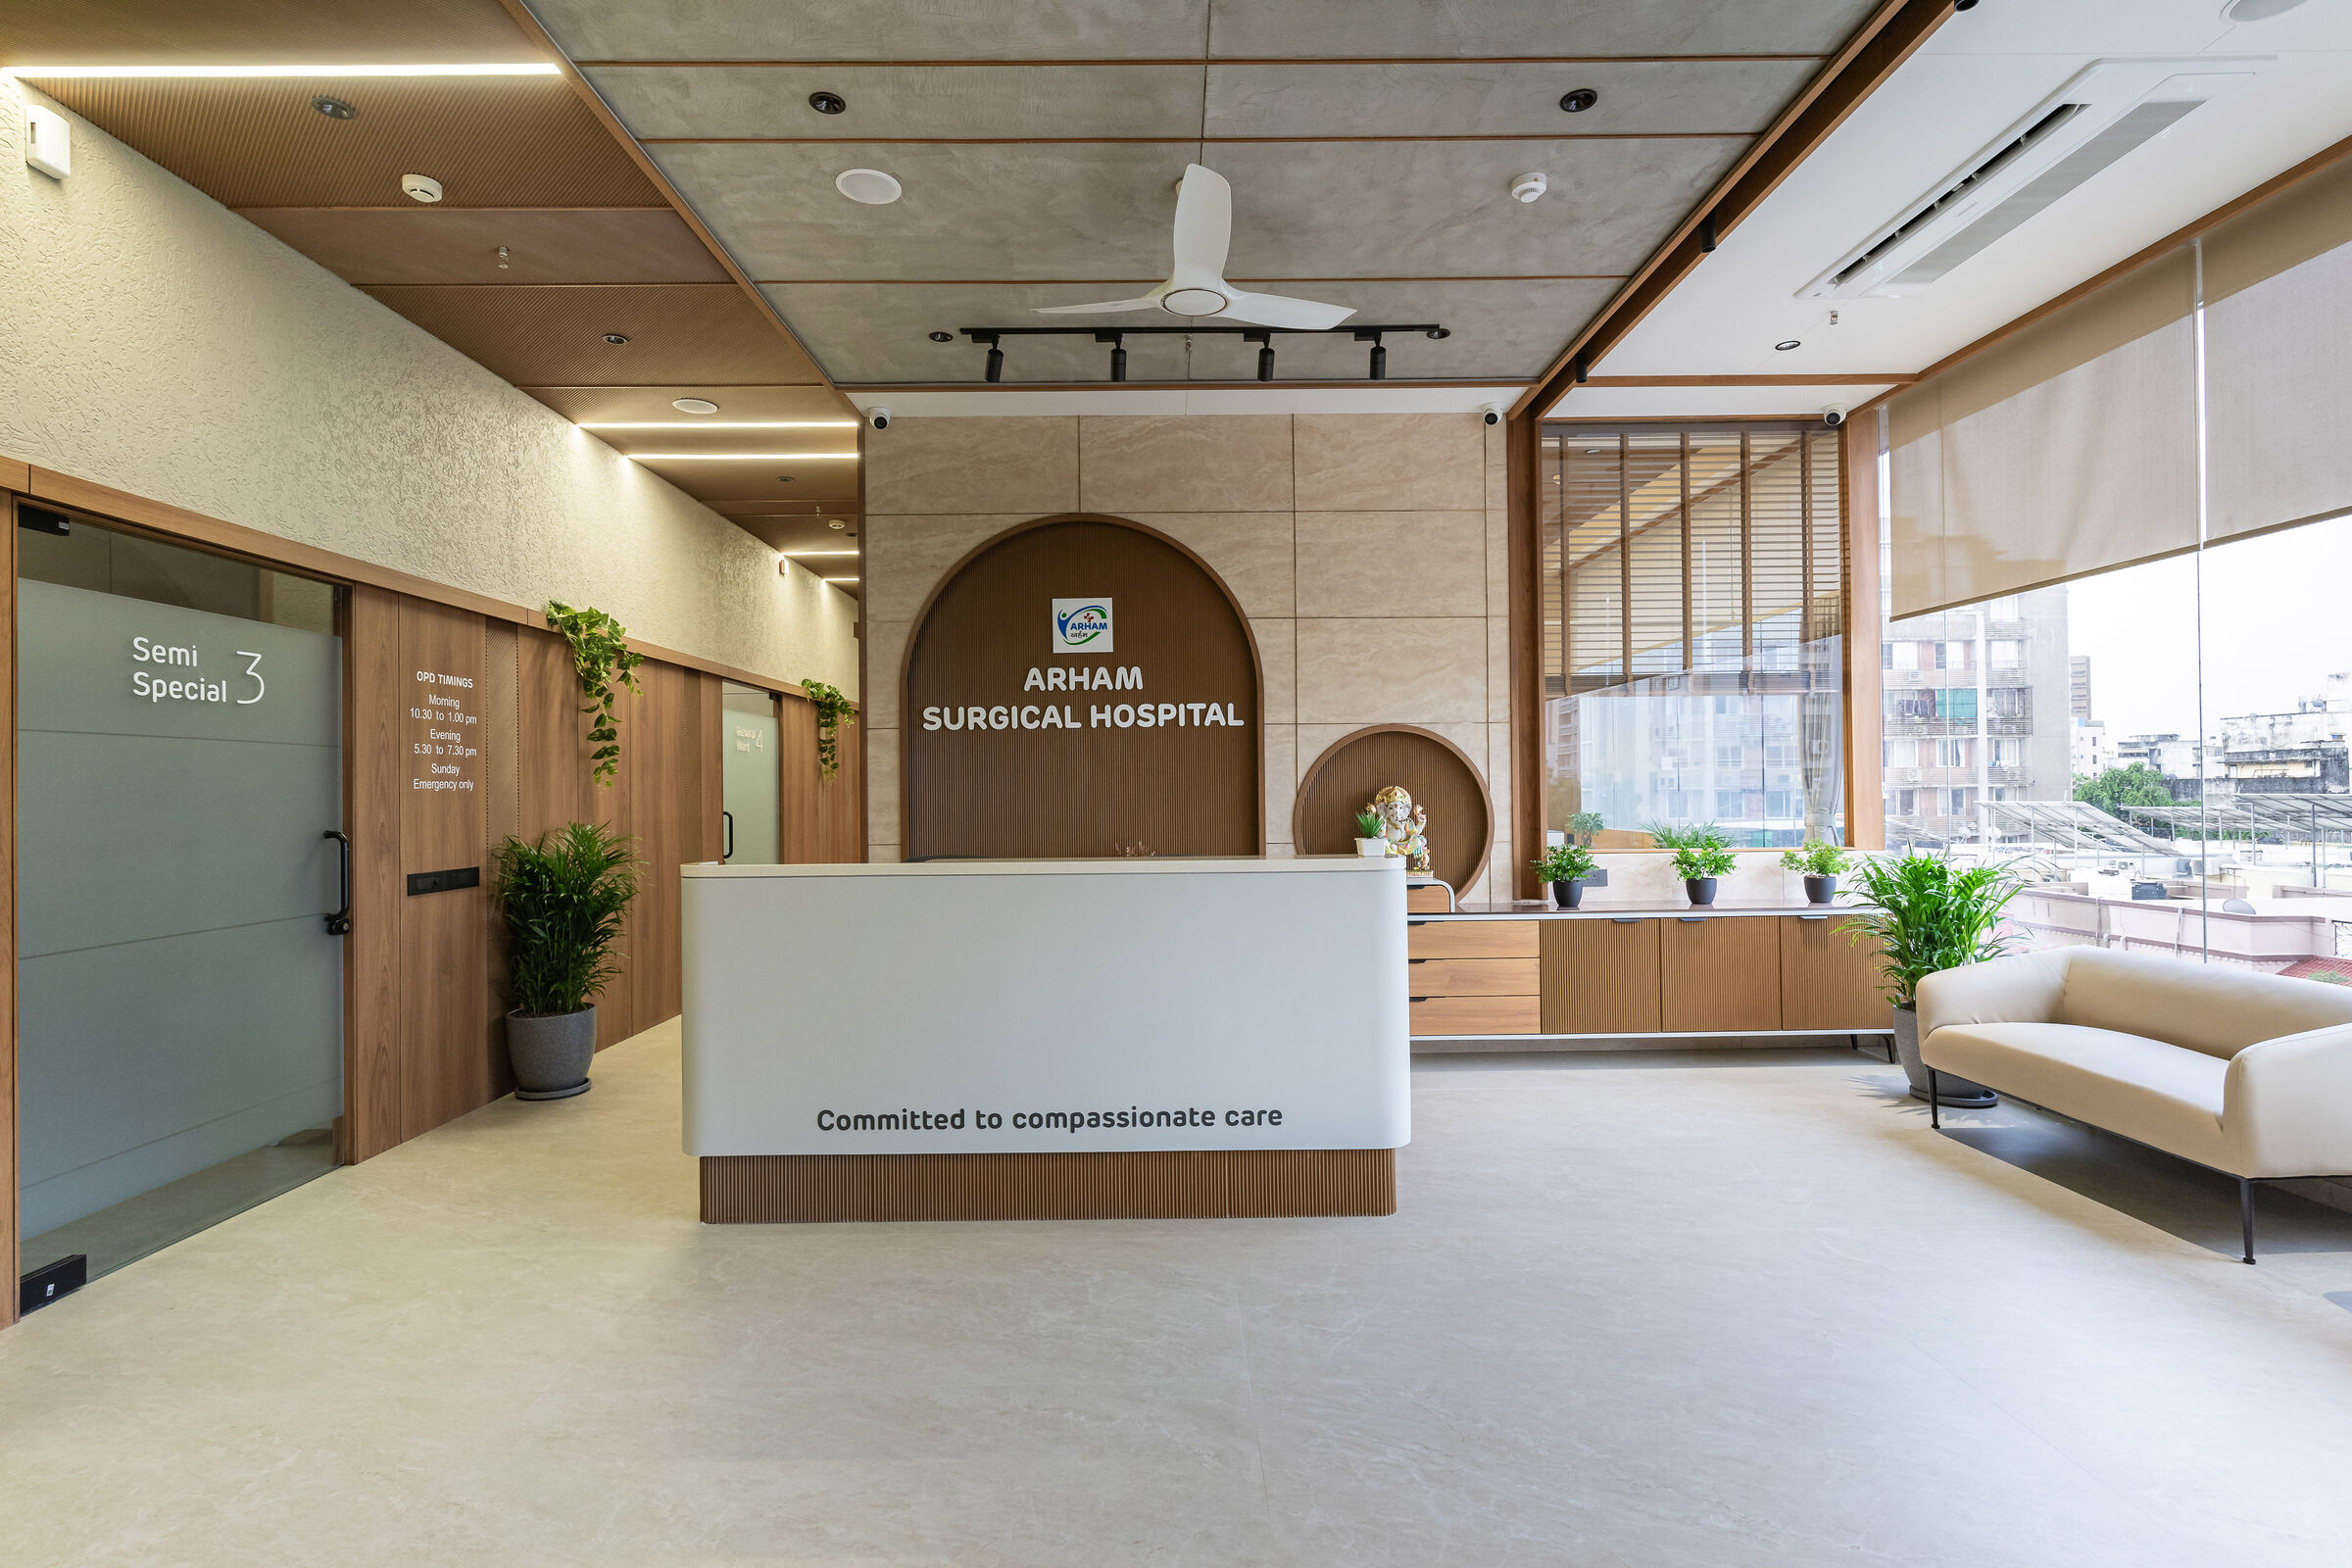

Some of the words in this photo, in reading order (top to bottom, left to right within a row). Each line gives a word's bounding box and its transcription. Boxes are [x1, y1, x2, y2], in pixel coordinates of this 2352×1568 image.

[132, 636, 198, 667] Semi
[132, 670, 227, 704] Special
[236, 650, 266, 705] 3
[416, 670, 436, 683] OPD
[438, 673, 473, 689] TIMINGS
[1024, 666, 1144, 691] ARHAM
[428, 694, 460, 710] Morning
[410, 708, 433, 720] 10.30
[436, 710, 445, 721] to
[448, 711, 465, 723] 1.00
[466, 714, 477, 726] pm
[922, 705, 1082, 731] SURGICAL
[1090, 703, 1245, 728] HOSPITAL
[429, 728, 461, 744] Evening
[756, 729, 763, 754] 4
[414, 743, 432, 755] 5.30
[436, 745, 444, 756] to
[447, 745, 465, 756] 7.30
[466, 747, 477, 759] pm
[431, 762, 461, 777] Sunday
[414, 778, 457, 792] Emergency
[459, 779, 474, 792] only
[816, 1108, 965, 1131] Committed
[975, 1109, 1003, 1130] to
[1012, 1106, 1216, 1135] compassionate
[1224, 1108, 1284, 1127] care
